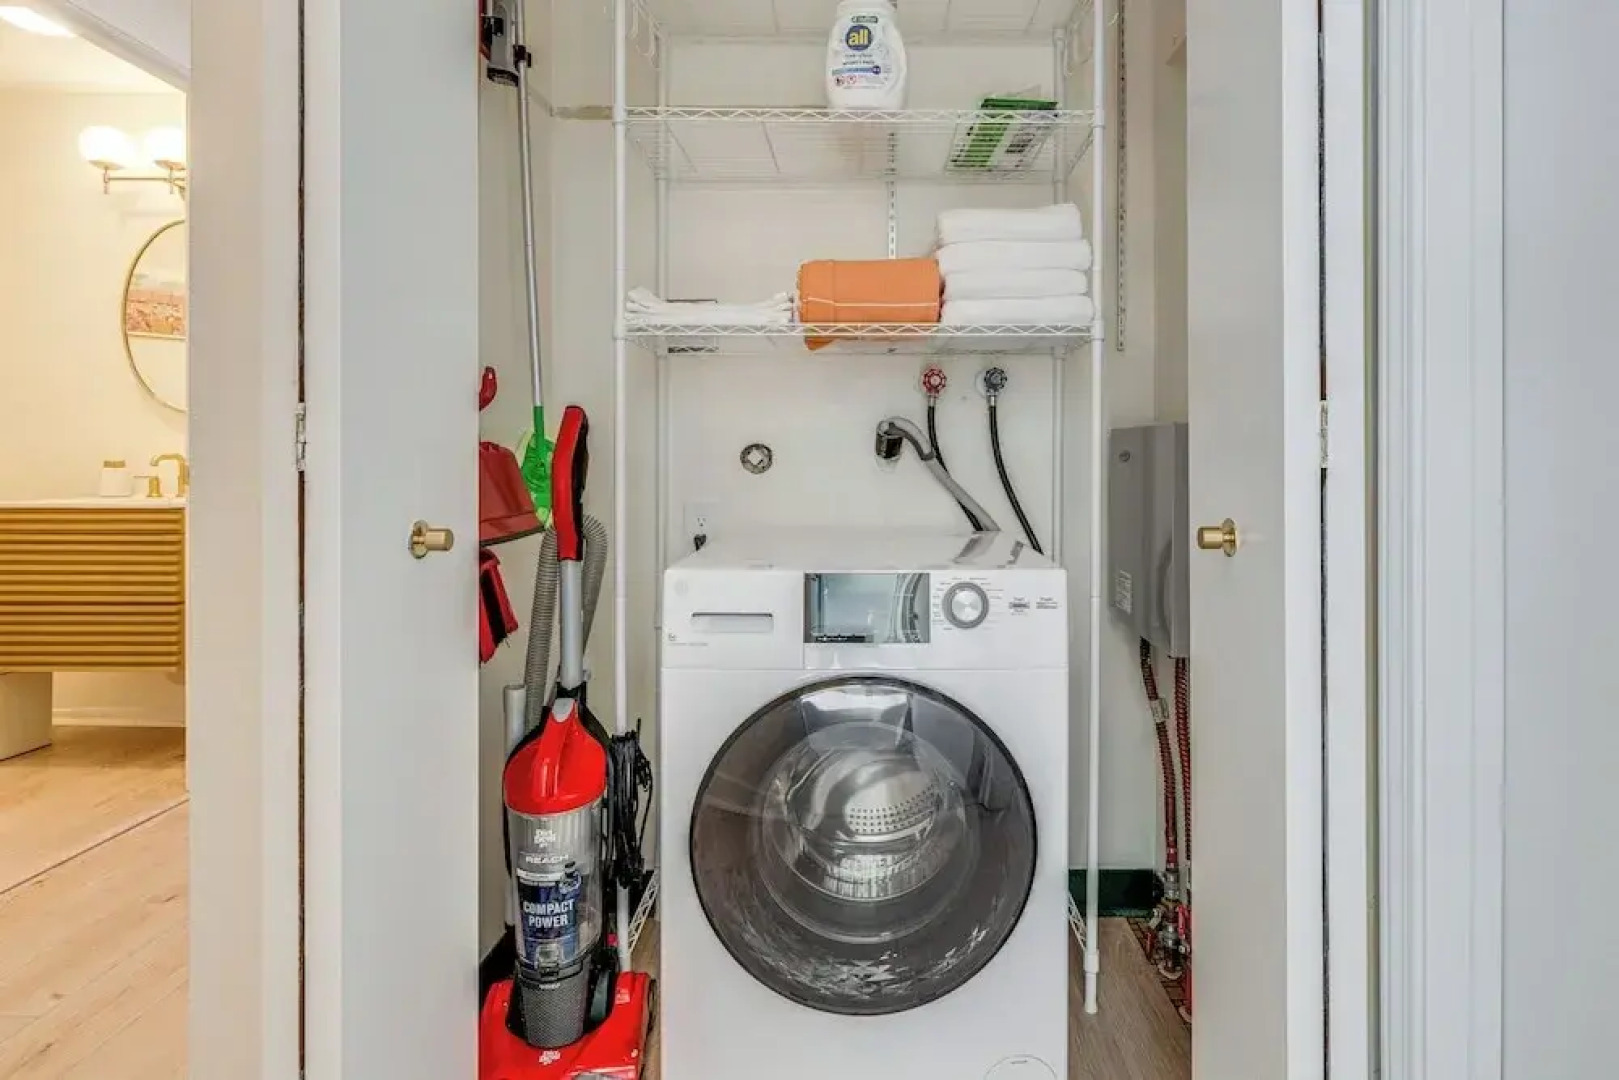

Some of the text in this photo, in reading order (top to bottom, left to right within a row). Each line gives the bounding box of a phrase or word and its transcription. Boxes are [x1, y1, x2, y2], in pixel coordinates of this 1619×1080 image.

[848, 28, 869, 46] all
[523, 899, 575, 915] COMPACT
[528, 914, 569, 929] POWER
